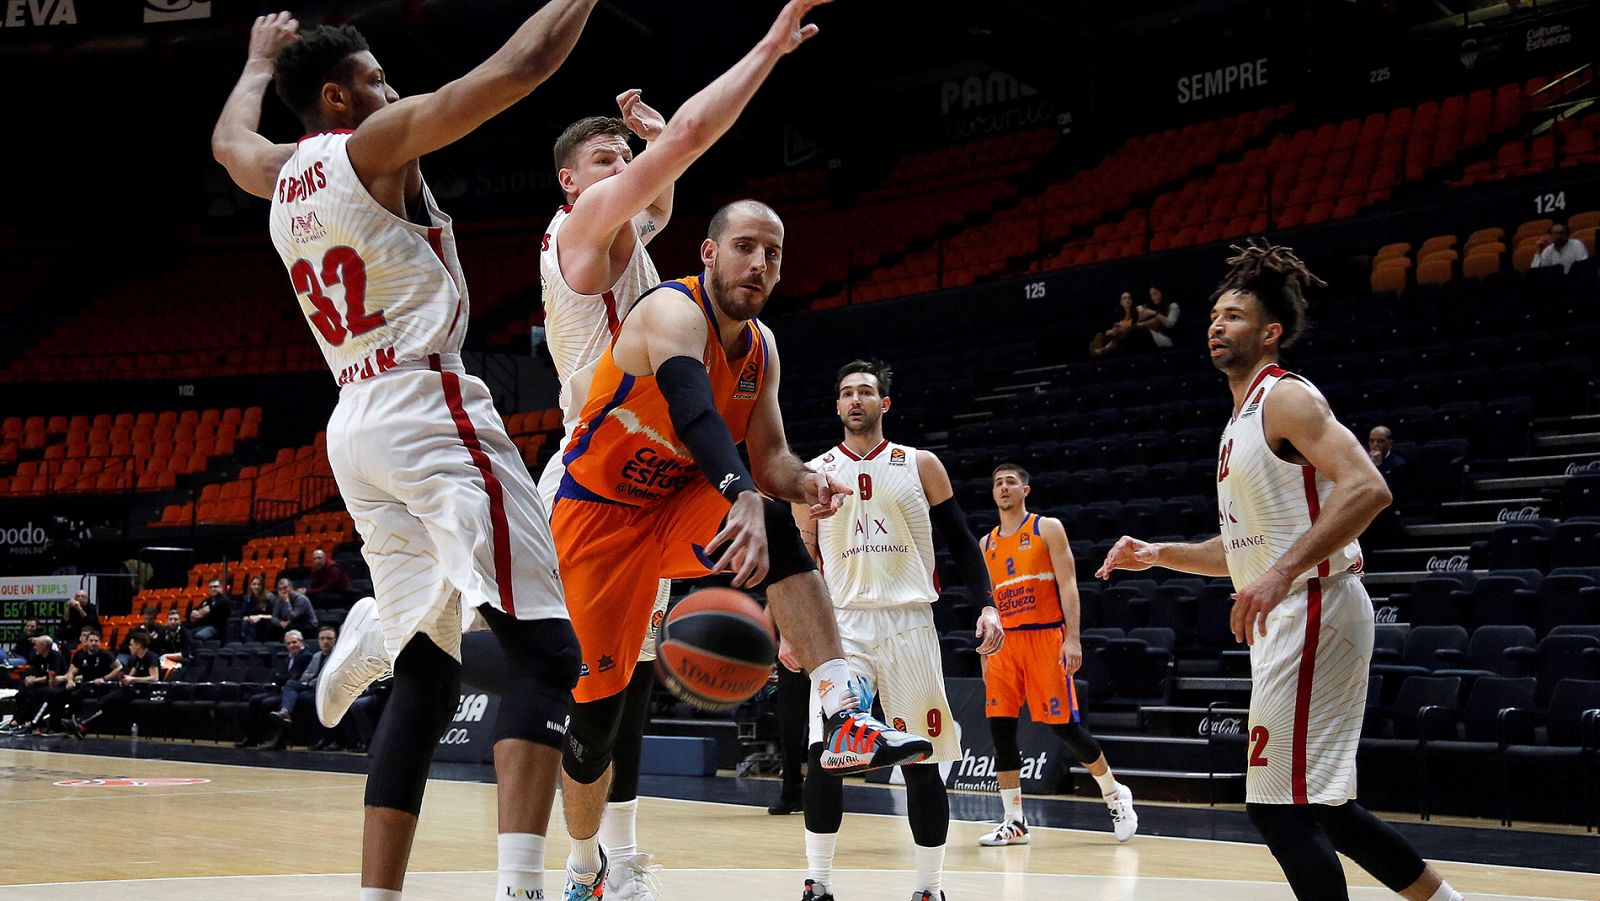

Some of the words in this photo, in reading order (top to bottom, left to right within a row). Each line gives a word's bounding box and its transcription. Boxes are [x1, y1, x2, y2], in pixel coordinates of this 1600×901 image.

[0, 0, 78, 28] EVA
[1177, 57, 1269, 104] SEMPRE
[1370, 67, 1391, 83] 225
[1533, 191, 1567, 214] 124
[291, 245, 388, 347] 32
[1024, 282, 1046, 299] 125
[178, 384, 195, 397] 102
[857, 472, 873, 501] 9
[865, 544, 909, 553] EXCHANGE
[1006, 557, 1015, 576] 2
[1, 584, 20, 596] QUE
[21, 584, 34, 595] UN
[1049, 697, 1062, 716] 2
[926, 708, 942, 738] 9
[1248, 725, 1270, 767] 2
[958, 748, 1048, 780] haat
